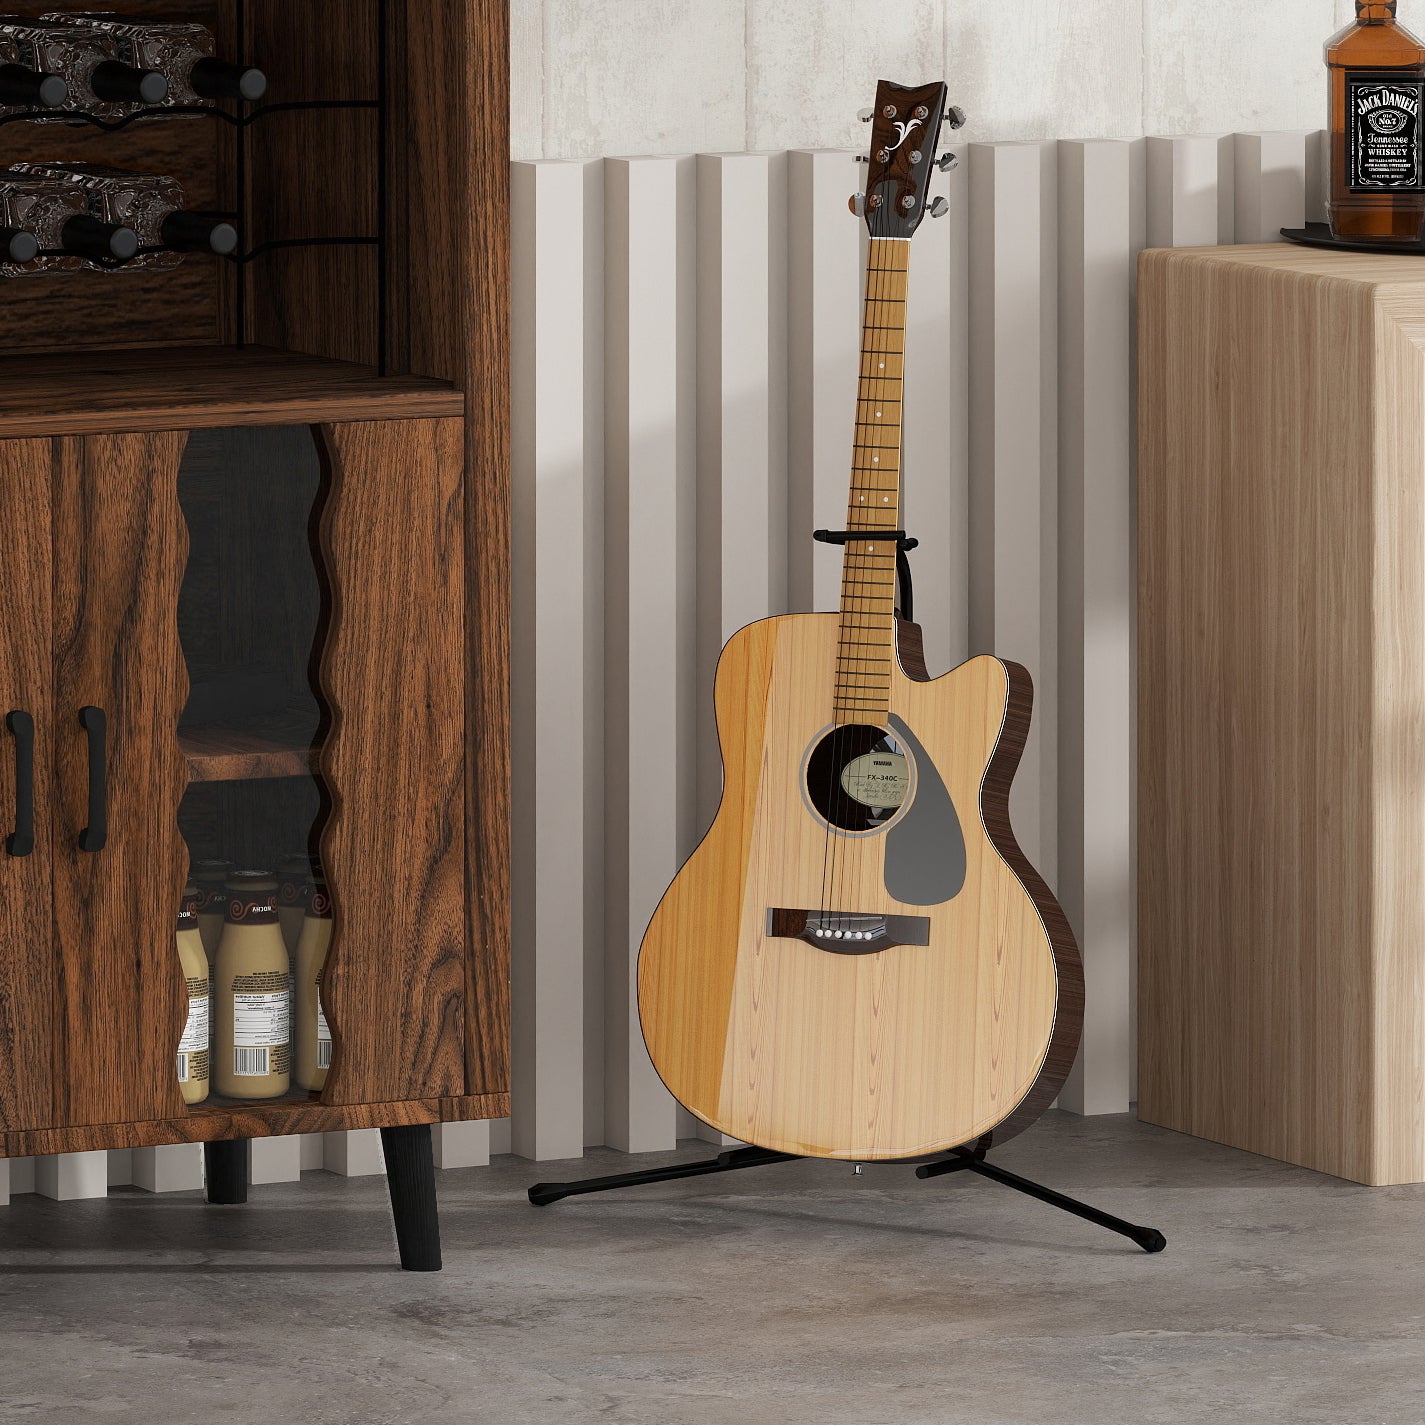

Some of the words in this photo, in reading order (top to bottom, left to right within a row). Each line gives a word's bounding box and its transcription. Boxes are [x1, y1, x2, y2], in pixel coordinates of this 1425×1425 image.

[1357, 94, 1382, 115] JACK
[1367, 132, 1408, 144] Tennessee
[1368, 148, 1408, 156] WHISKEY
